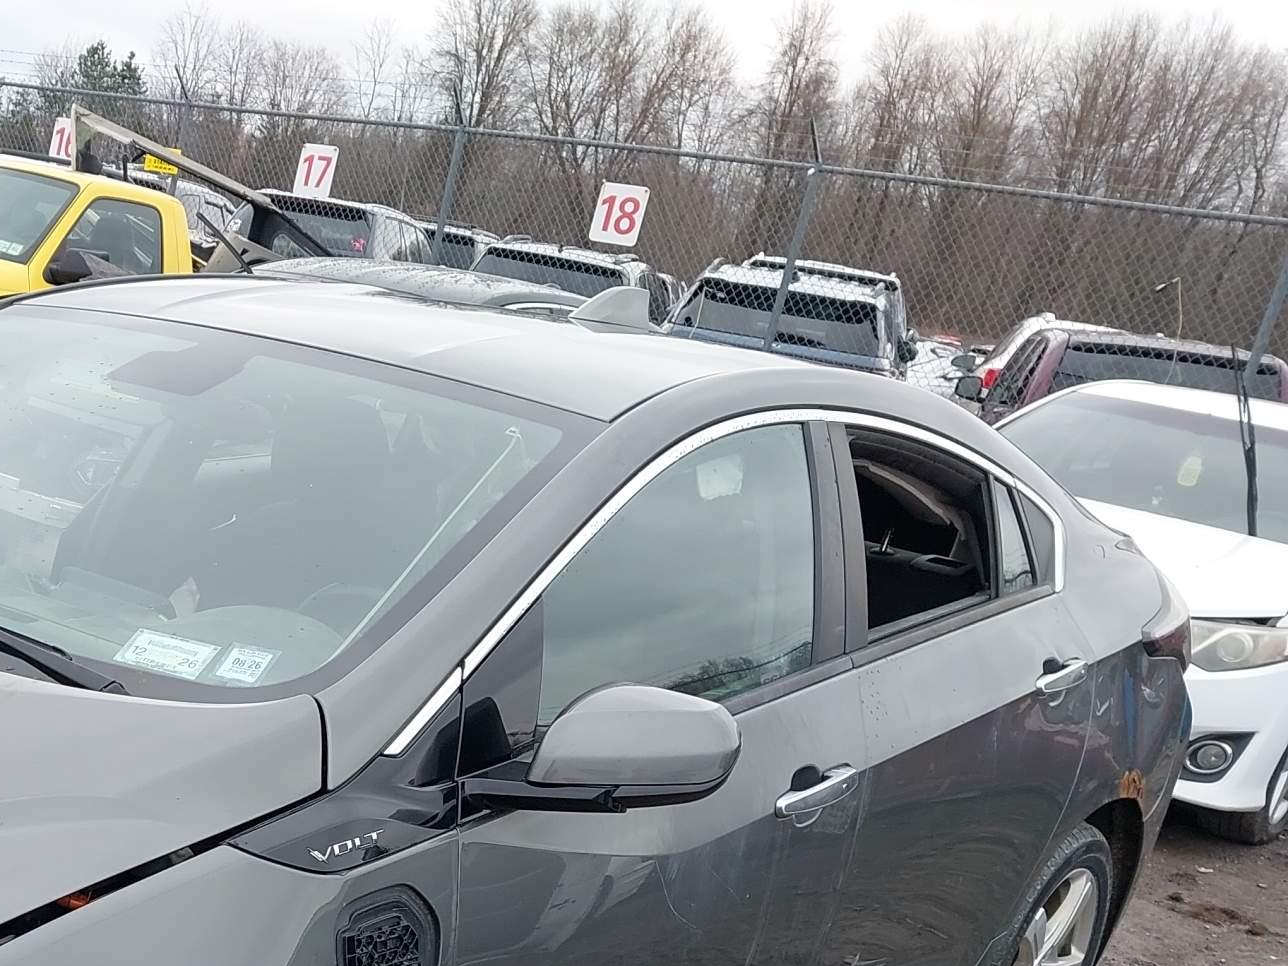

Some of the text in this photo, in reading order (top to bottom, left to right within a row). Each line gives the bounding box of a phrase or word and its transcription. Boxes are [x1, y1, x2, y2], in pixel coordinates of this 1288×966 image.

[303, 154, 333, 188] 17
[601, 195, 641, 235] 18
[132, 645, 148, 657] 12
[178, 657, 199, 669] 26
[248, 660, 263, 670] 26
[307, 829, 385, 864] VOLT
